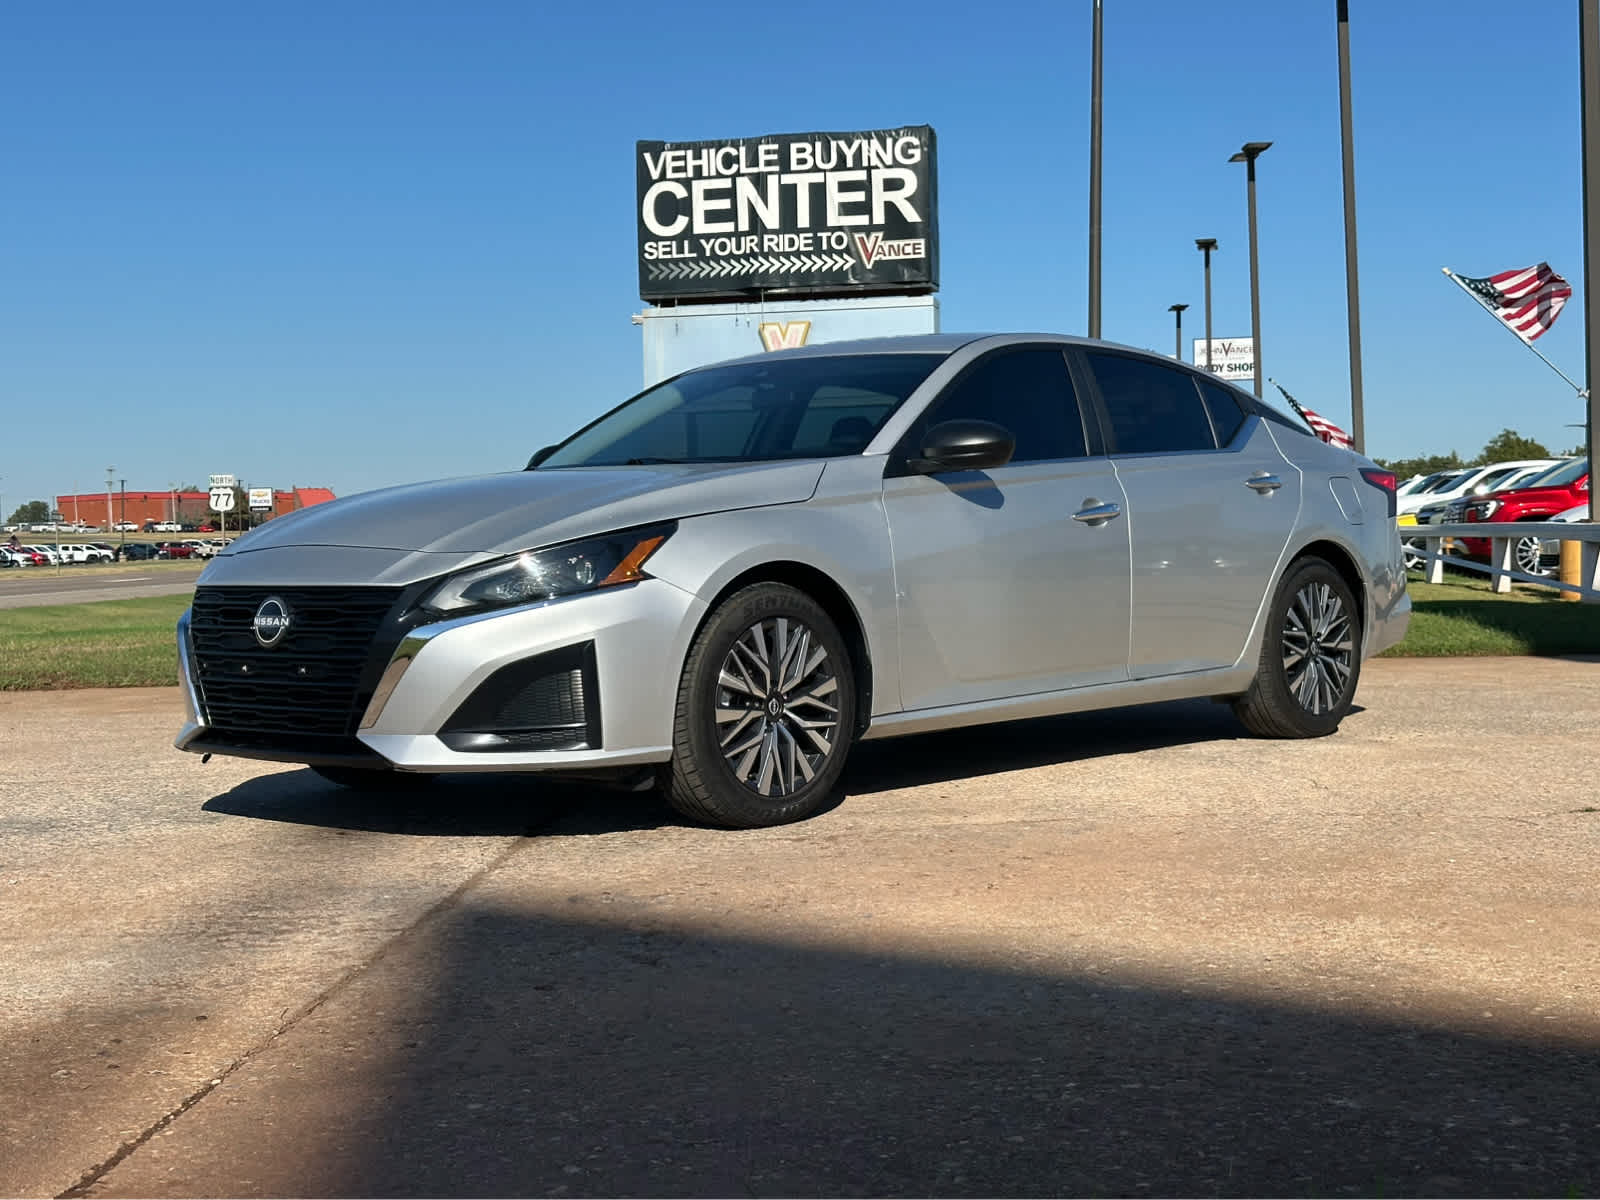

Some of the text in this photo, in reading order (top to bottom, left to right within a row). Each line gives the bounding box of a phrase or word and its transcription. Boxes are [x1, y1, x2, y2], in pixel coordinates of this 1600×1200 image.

[644, 136, 921, 180] VEHICLE BUYING
[642, 167, 922, 236] CENTER
[644, 231, 924, 269] SELL YOUR RIDE TO VANCE
[1197, 363, 1224, 373] DY
[211, 476, 233, 485] NORTH
[212, 493, 232, 507] 77
[254, 617, 289, 626] NISSAN
